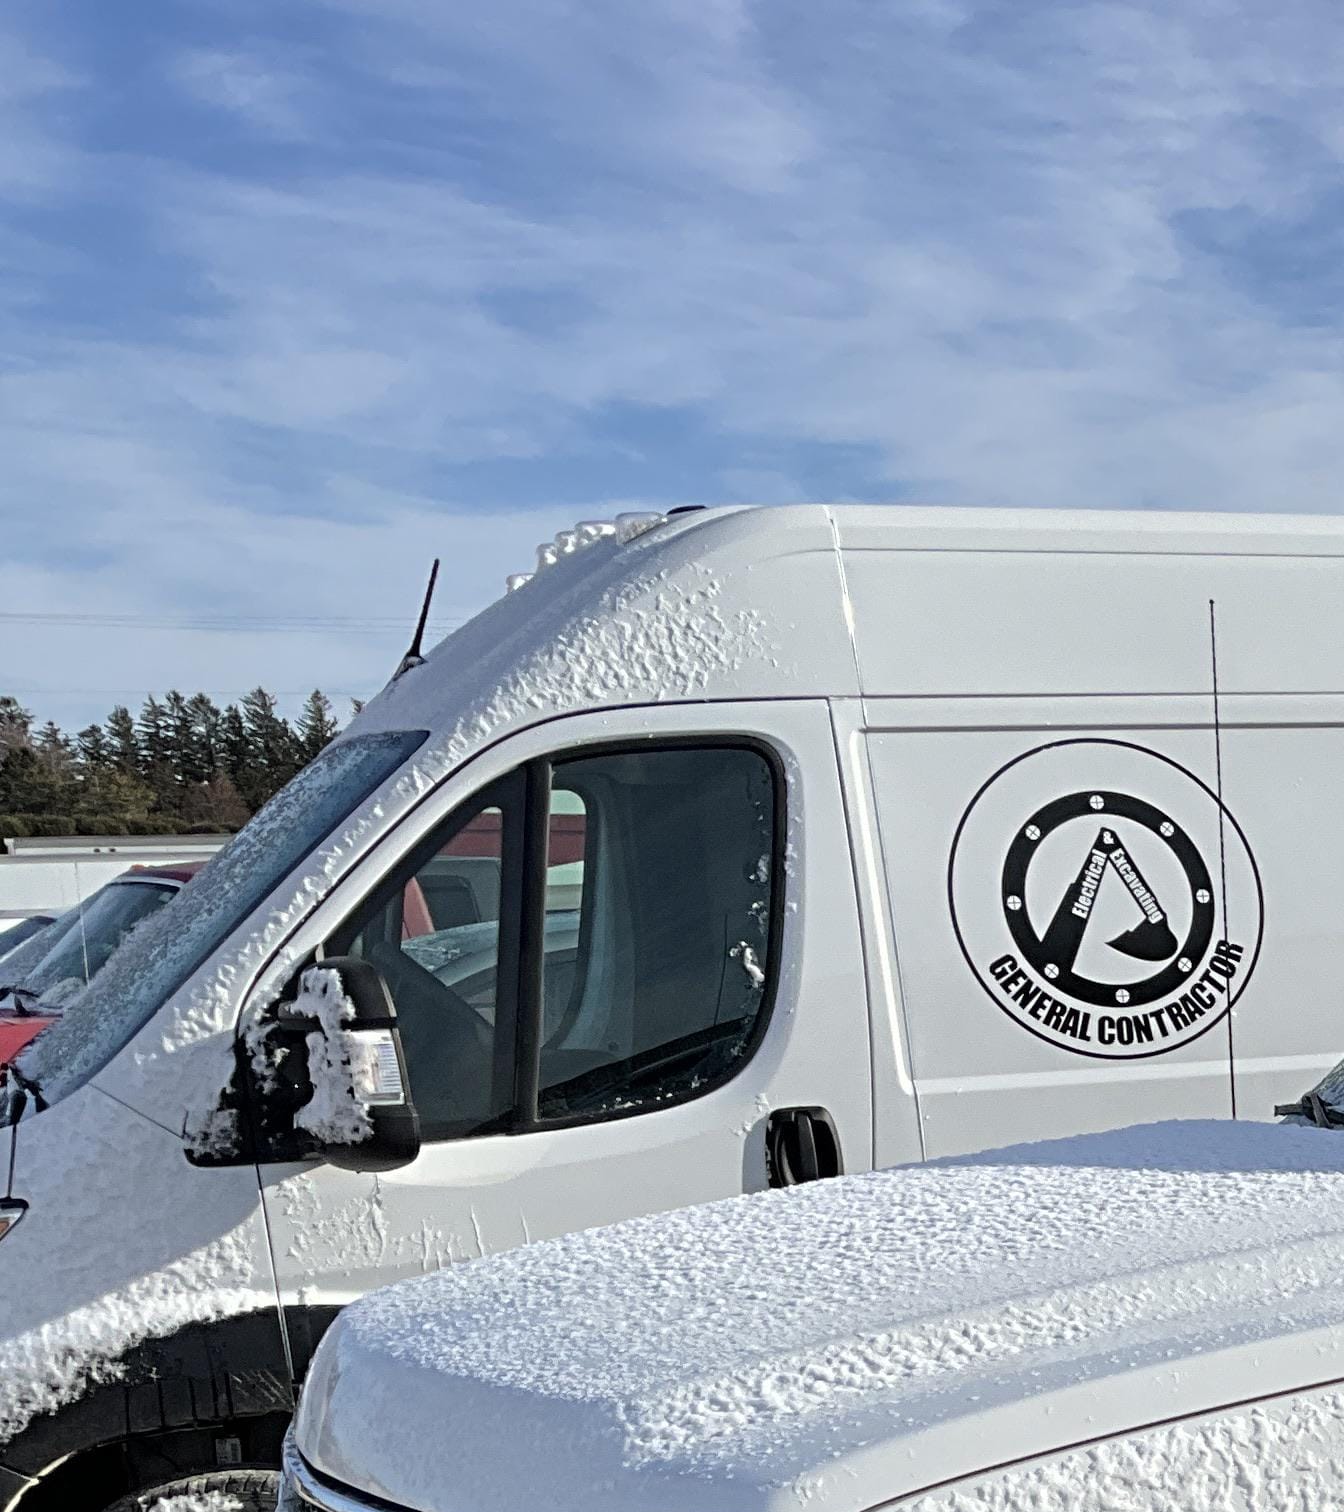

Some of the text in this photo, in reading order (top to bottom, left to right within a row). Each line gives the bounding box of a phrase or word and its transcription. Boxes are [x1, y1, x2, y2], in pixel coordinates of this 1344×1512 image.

[1071, 849, 1108, 919] Electrical
[1109, 848, 1164, 924] Excavating
[989, 940, 1244, 1045] GENERAL CONTRACTOR
